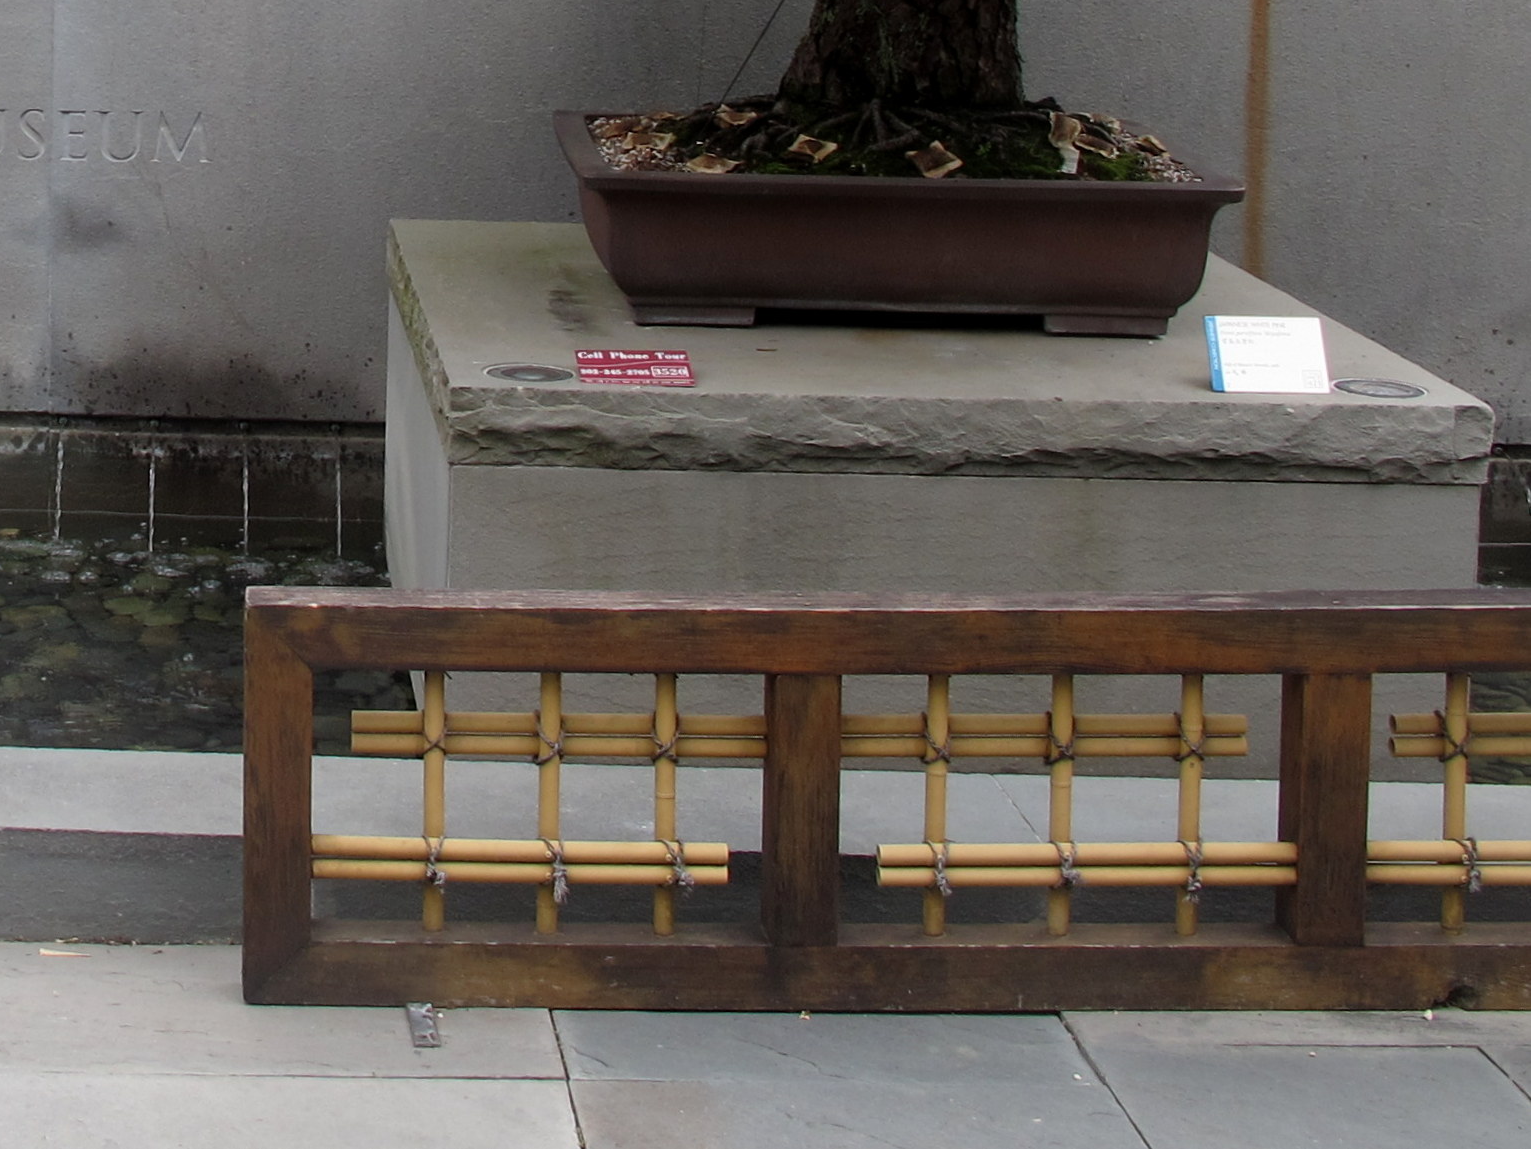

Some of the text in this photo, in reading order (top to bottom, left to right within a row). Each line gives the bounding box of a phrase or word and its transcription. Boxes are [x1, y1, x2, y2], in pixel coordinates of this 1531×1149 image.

[577, 351, 687, 360] Cell Phone Tour
